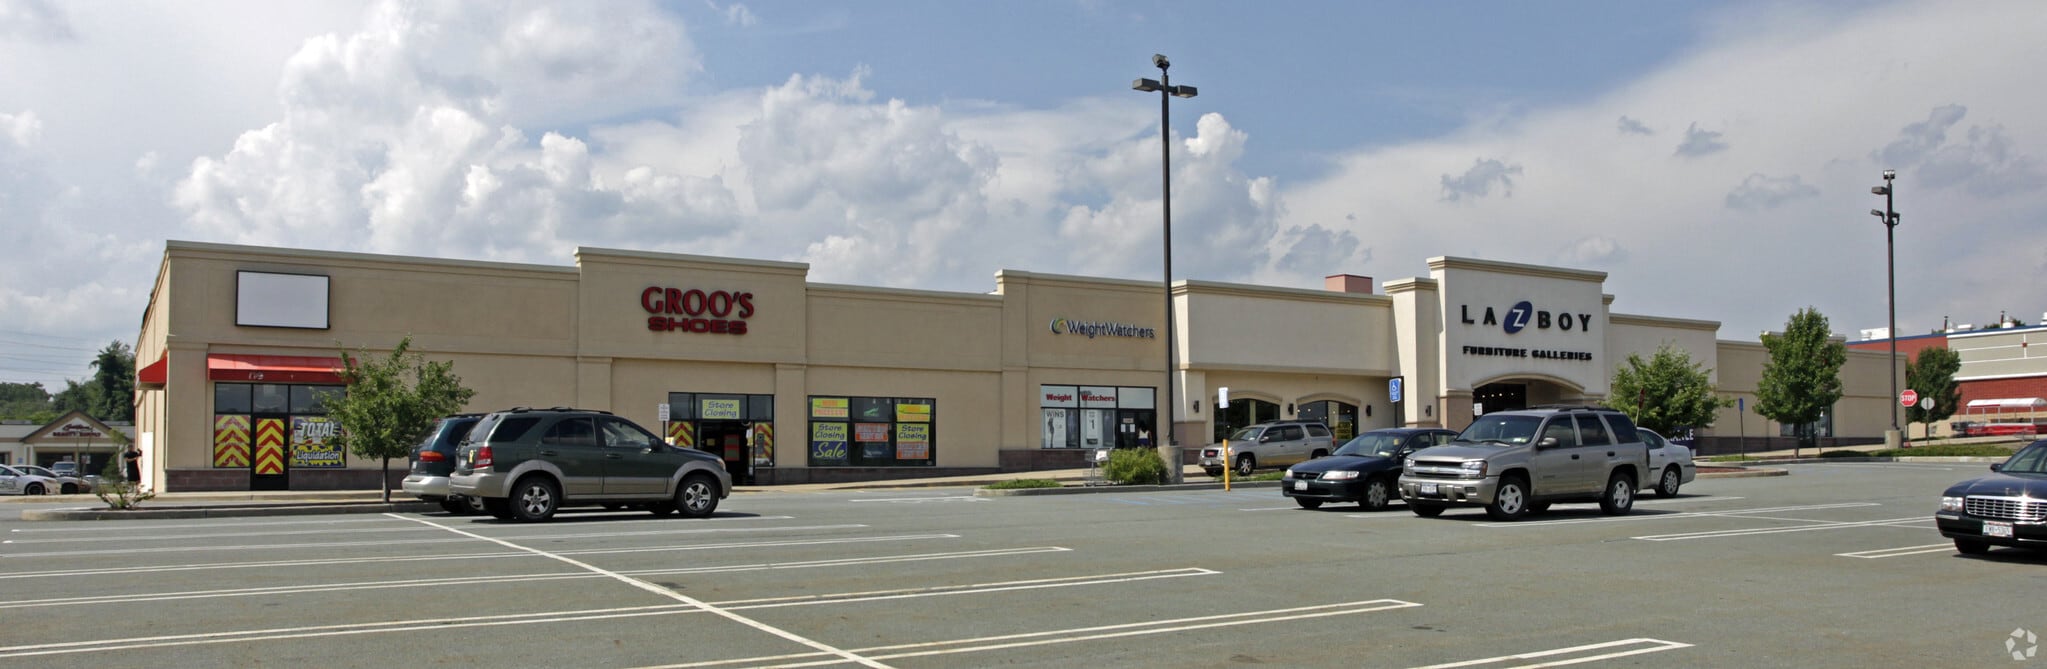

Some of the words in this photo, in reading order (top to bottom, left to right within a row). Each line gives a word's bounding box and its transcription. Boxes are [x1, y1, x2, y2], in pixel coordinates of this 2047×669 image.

[641, 286, 755, 319] GROO'S
[647, 316, 748, 335] SHOES
[1462, 345, 1527, 358] FURNITURE
[1531, 349, 1592, 361] GALLERIES
[1046, 394, 1072, 402] Weight
[1081, 393, 1116, 402] Watchers
[1900, 394, 1915, 402] STOP
[708, 401, 734, 409] Store
[704, 409, 737, 418] Closing
[300, 422, 336, 437] TOTAL
[815, 431, 845, 440] Closing
[898, 432, 927, 441] Closing
[813, 441, 846, 458] Sale
[296, 450, 340, 465] Liquidation
